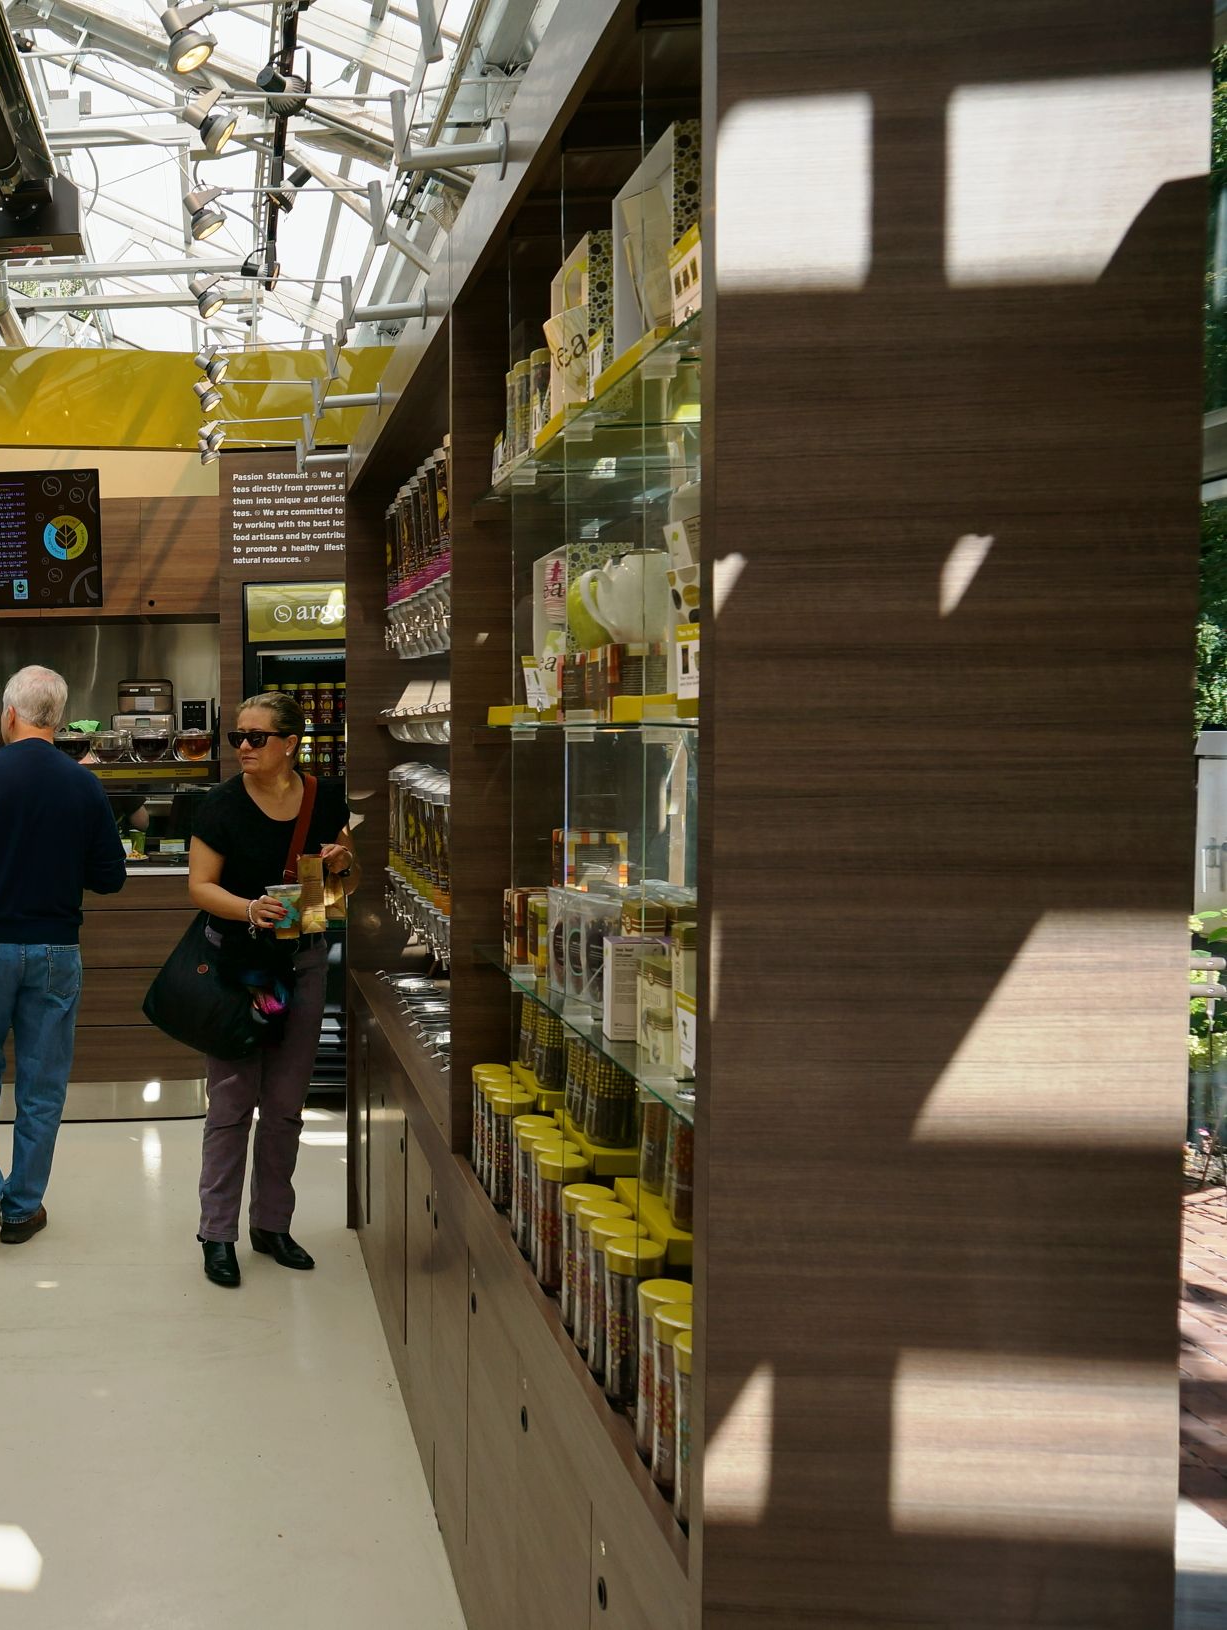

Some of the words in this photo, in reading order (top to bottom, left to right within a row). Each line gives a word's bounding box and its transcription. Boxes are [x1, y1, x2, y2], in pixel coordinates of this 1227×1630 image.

[233, 473, 263, 481] Passion
[267, 472, 308, 480] Statement
[252, 484, 282, 493] directly
[305, 484, 336, 493] growers
[233, 497, 253, 505] them
[275, 496, 300, 505] unique
[233, 509, 252, 517] teas.
[290, 508, 332, 516] committed
[233, 521, 242, 529] by
[245, 520, 275, 529] working
[278, 520, 295, 528] with
[252, 532, 284, 540] artisans
[302, 532, 311, 541] by
[233, 545, 241, 553] to
[246, 545, 277, 554] promote
[291, 544, 319, 553] healthy
[233, 556, 260, 564] natural
[296, 603, 346, 624] argo
